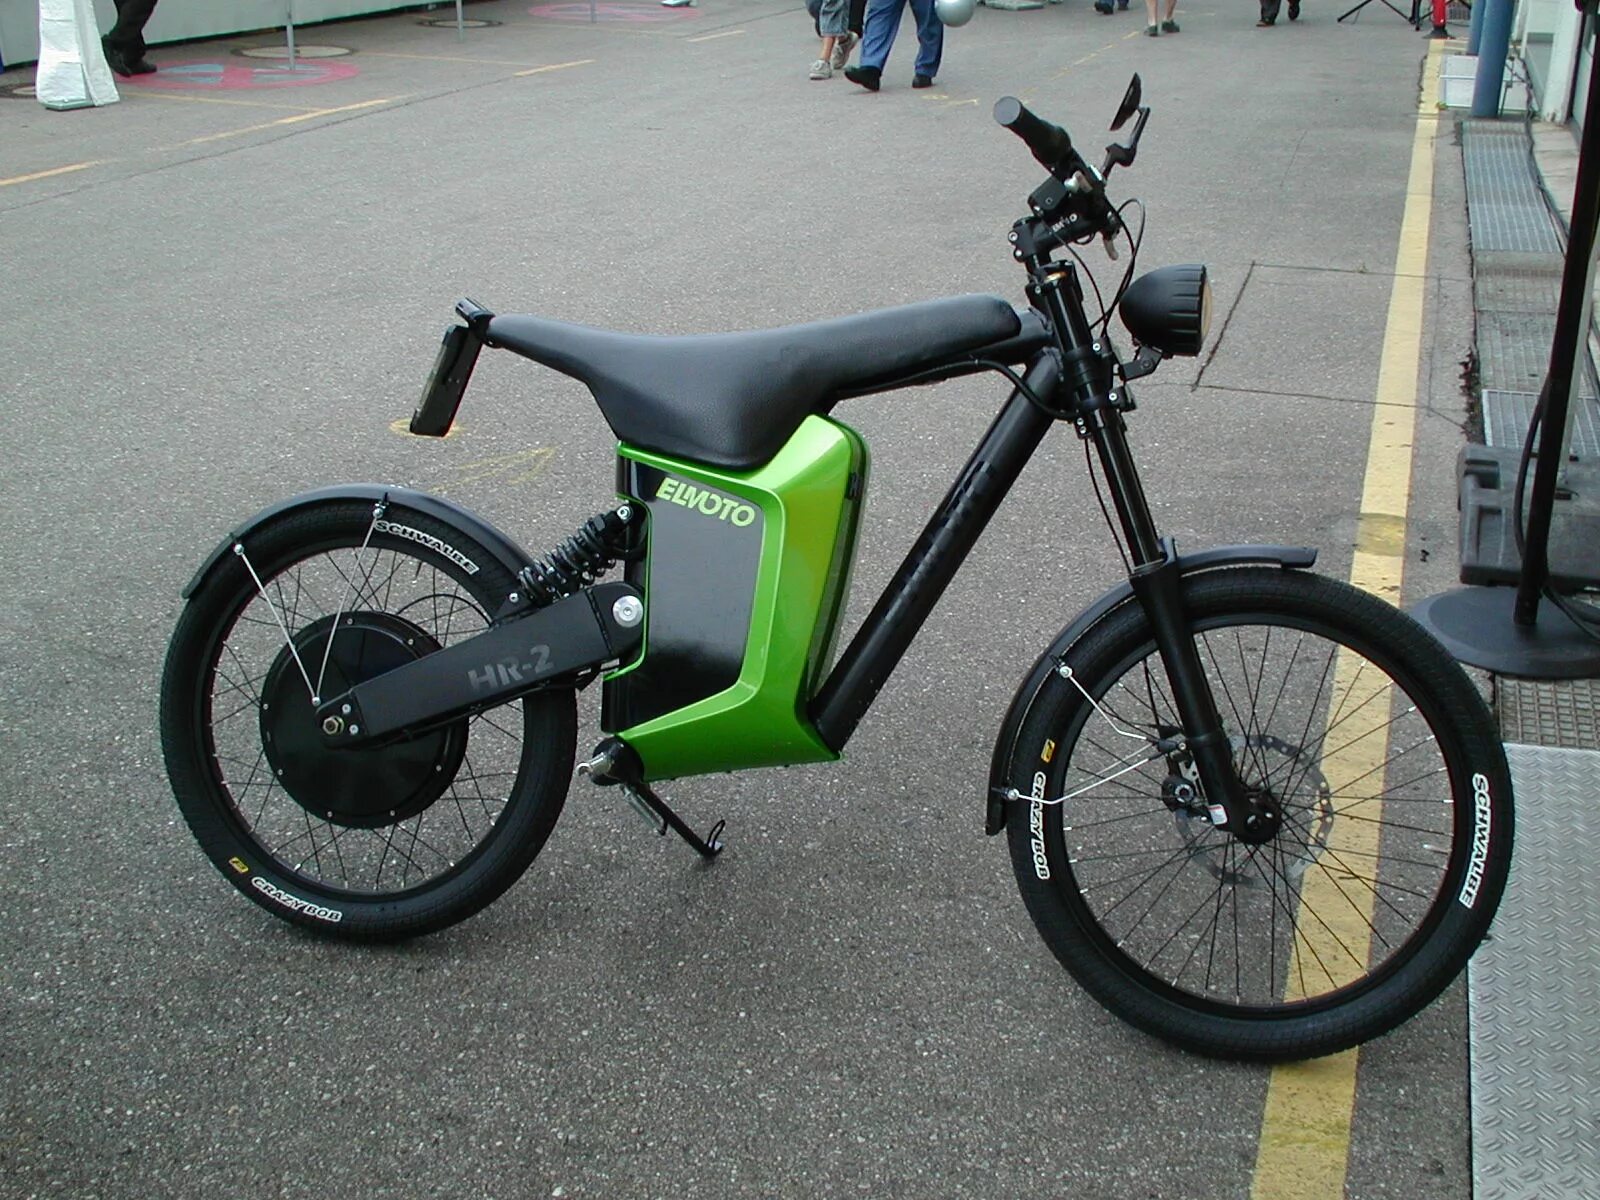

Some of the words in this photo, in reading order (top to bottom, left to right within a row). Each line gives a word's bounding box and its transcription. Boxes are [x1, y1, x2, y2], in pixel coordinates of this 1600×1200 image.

[656, 477, 755, 527] ELMOTO
[374, 520, 480, 575] SCHWALBE
[467, 644, 555, 690] HR-2
[1030, 771, 1046, 839] CRAZY
[1031, 838, 1050, 880] BOB
[1459, 773, 1491, 909] SCHWALBE
[251, 876, 305, 910] CRAZY
[303, 904, 342, 922] BOB
